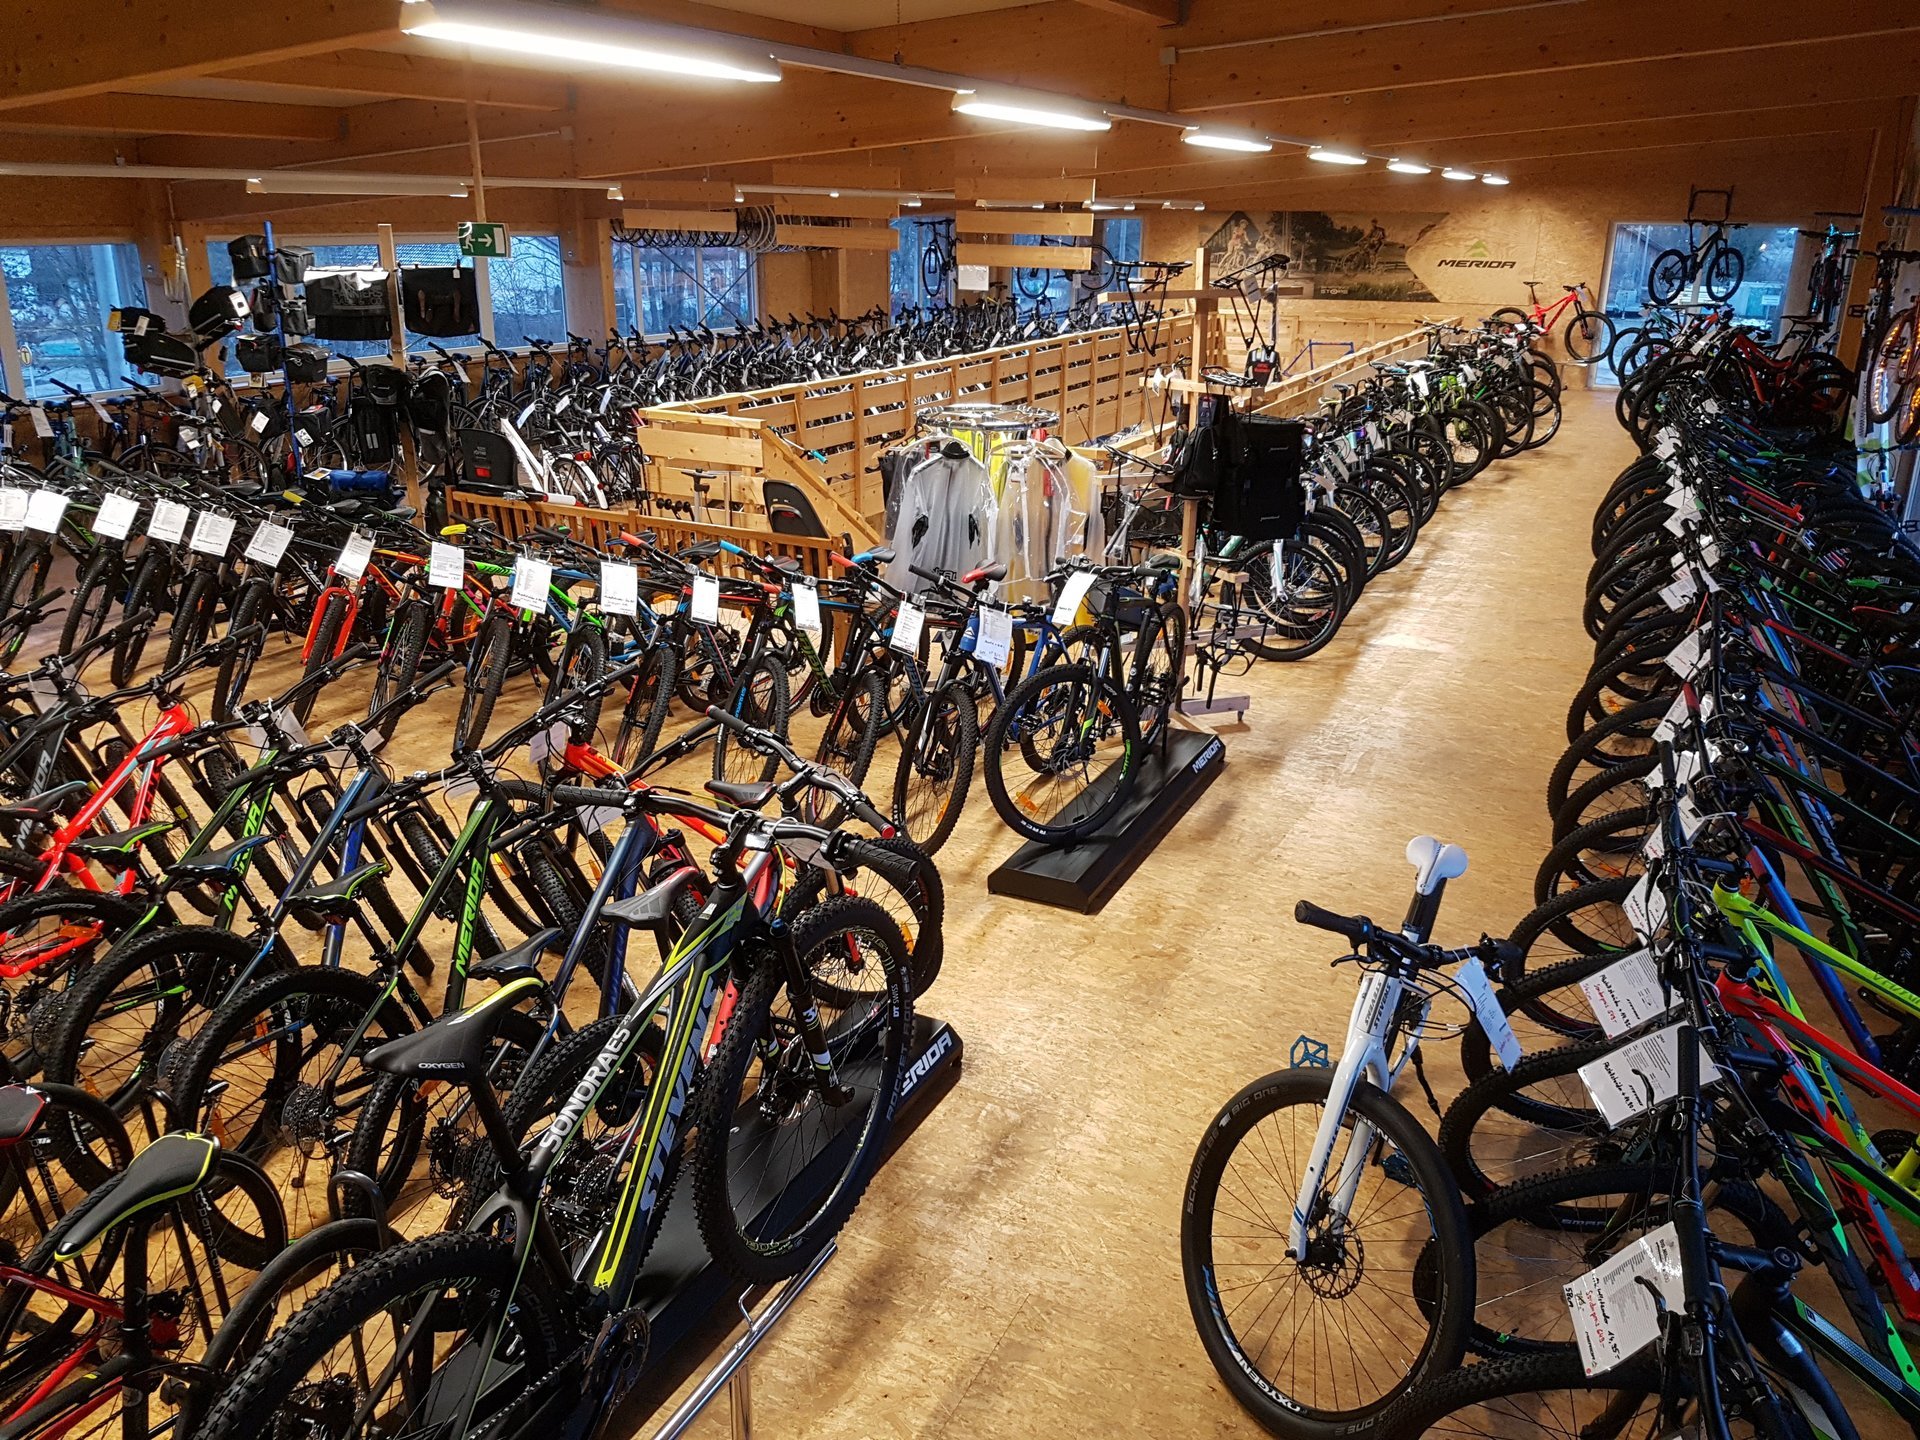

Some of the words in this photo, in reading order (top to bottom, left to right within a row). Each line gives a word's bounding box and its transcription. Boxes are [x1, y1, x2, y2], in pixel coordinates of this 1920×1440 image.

[1437, 259, 1517, 269] MERIDA
[1193, 739, 1221, 773] MERIDA
[455, 857, 483, 978] MERIDA
[1364, 981, 1382, 1027] STEVENS
[1373, 983, 1391, 1030] STEVENS
[900, 1031, 953, 1097] ERIDA
[640, 977, 717, 1212] STEVENS
[1231, 1097, 1251, 1115] BIG
[1254, 1086, 1278, 1101] ONE
[1187, 1127, 1219, 1215] SCHWALBE
[1239, 1359, 1301, 1413] OXYGEN
